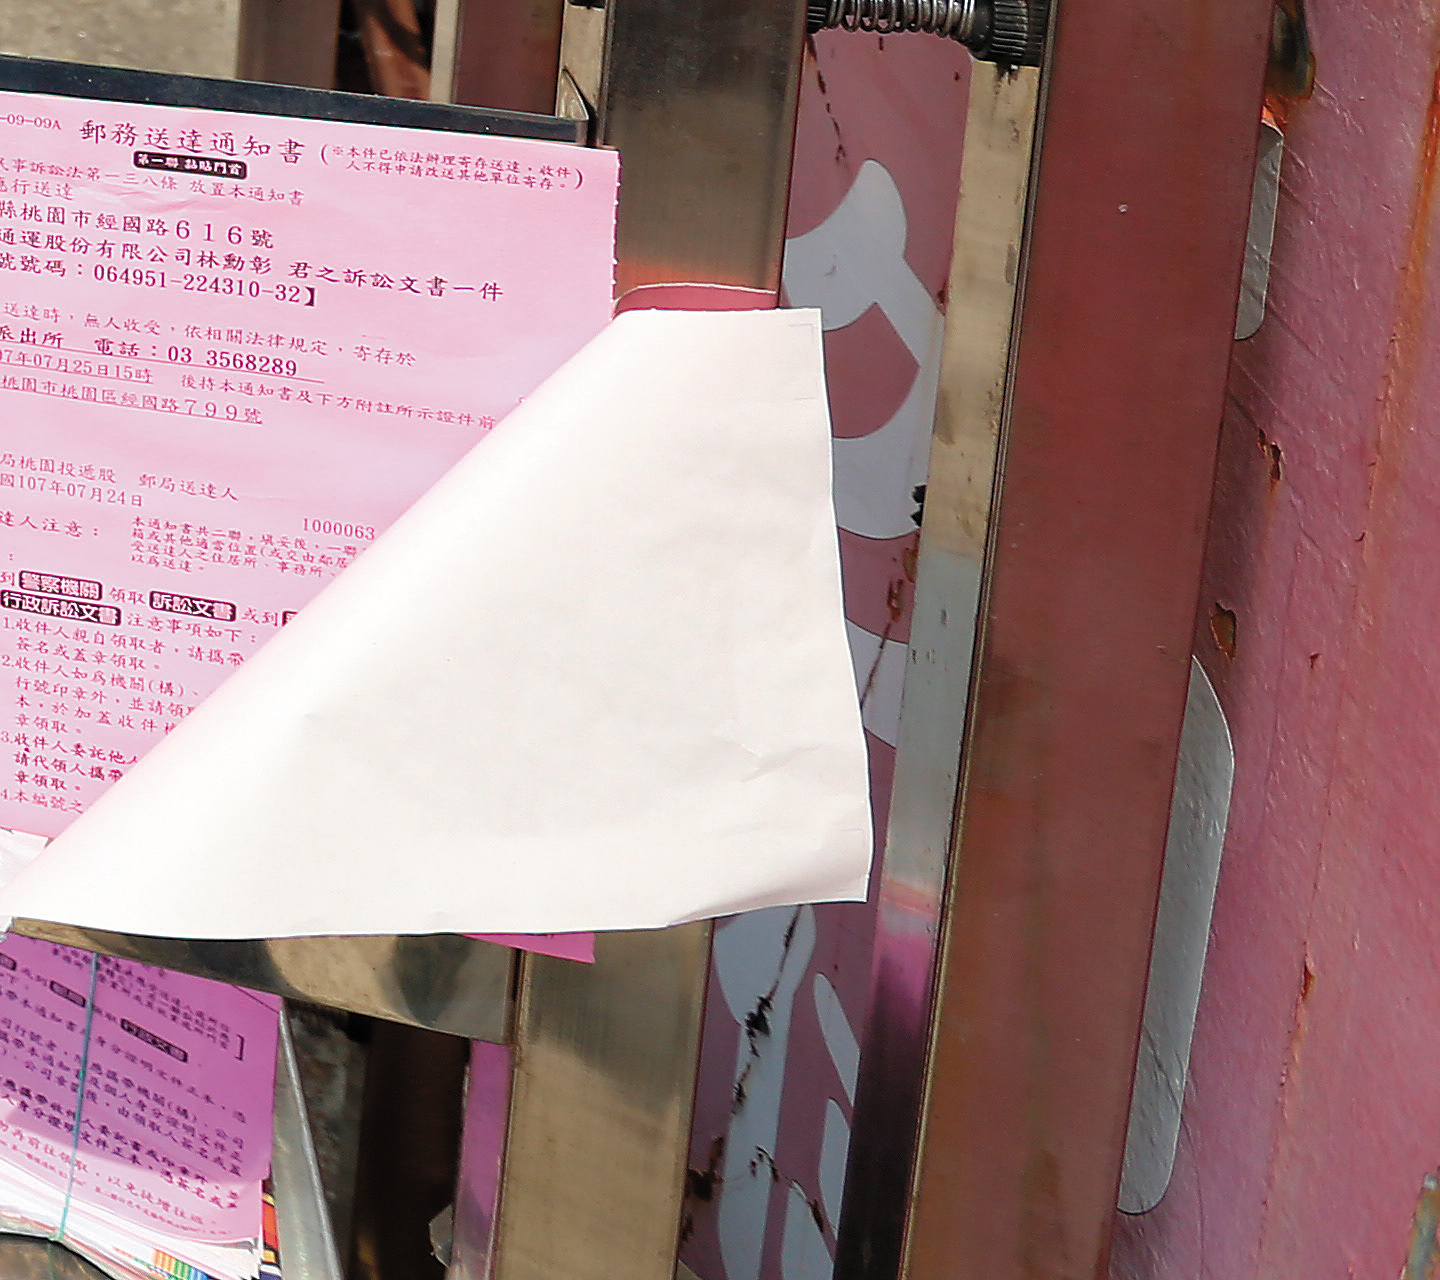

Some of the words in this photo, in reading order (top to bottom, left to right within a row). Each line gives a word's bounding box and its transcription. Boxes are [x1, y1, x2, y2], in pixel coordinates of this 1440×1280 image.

[79, 119, 305, 165] 郵務送達通知書
[204, 348, 298, 376] 3568289
